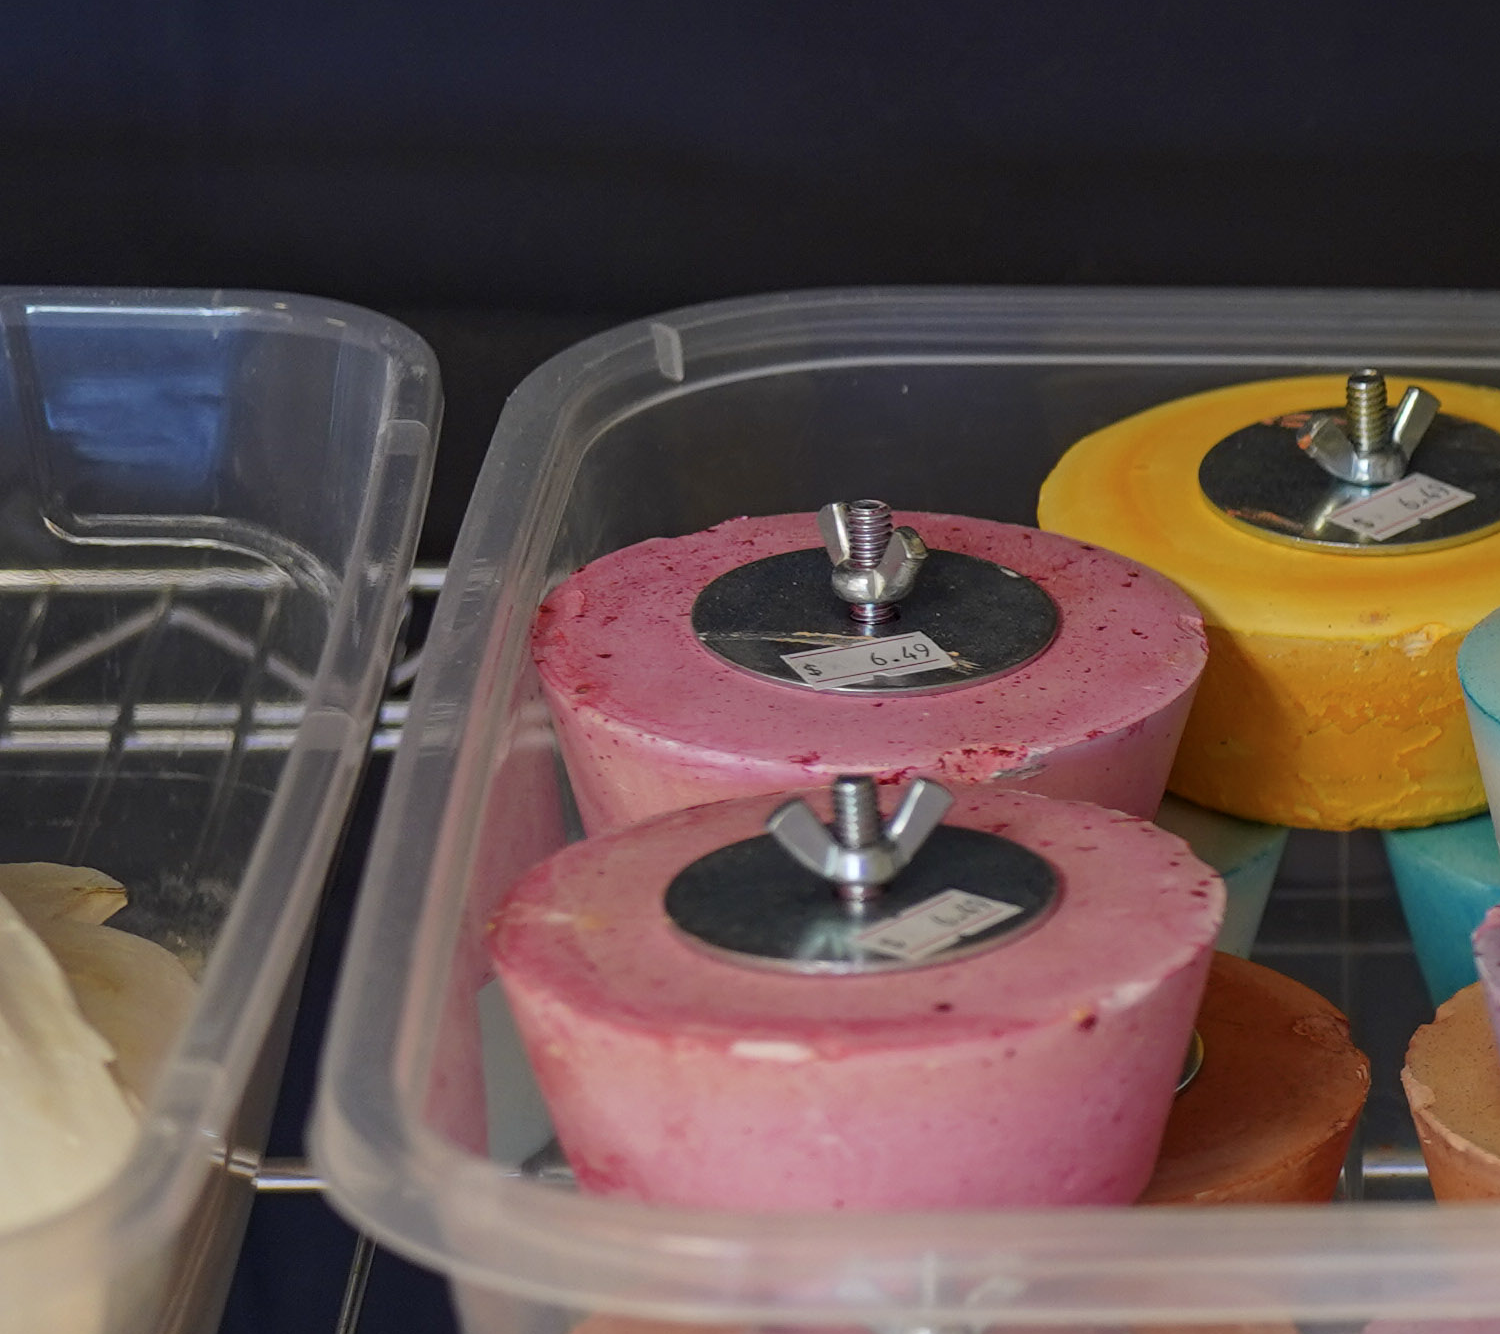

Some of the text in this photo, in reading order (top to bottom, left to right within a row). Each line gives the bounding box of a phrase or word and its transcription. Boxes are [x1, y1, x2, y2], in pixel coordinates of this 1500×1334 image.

[1399, 483, 1449, 509] 6.49
[803, 642, 930, 676] $ 6.49
